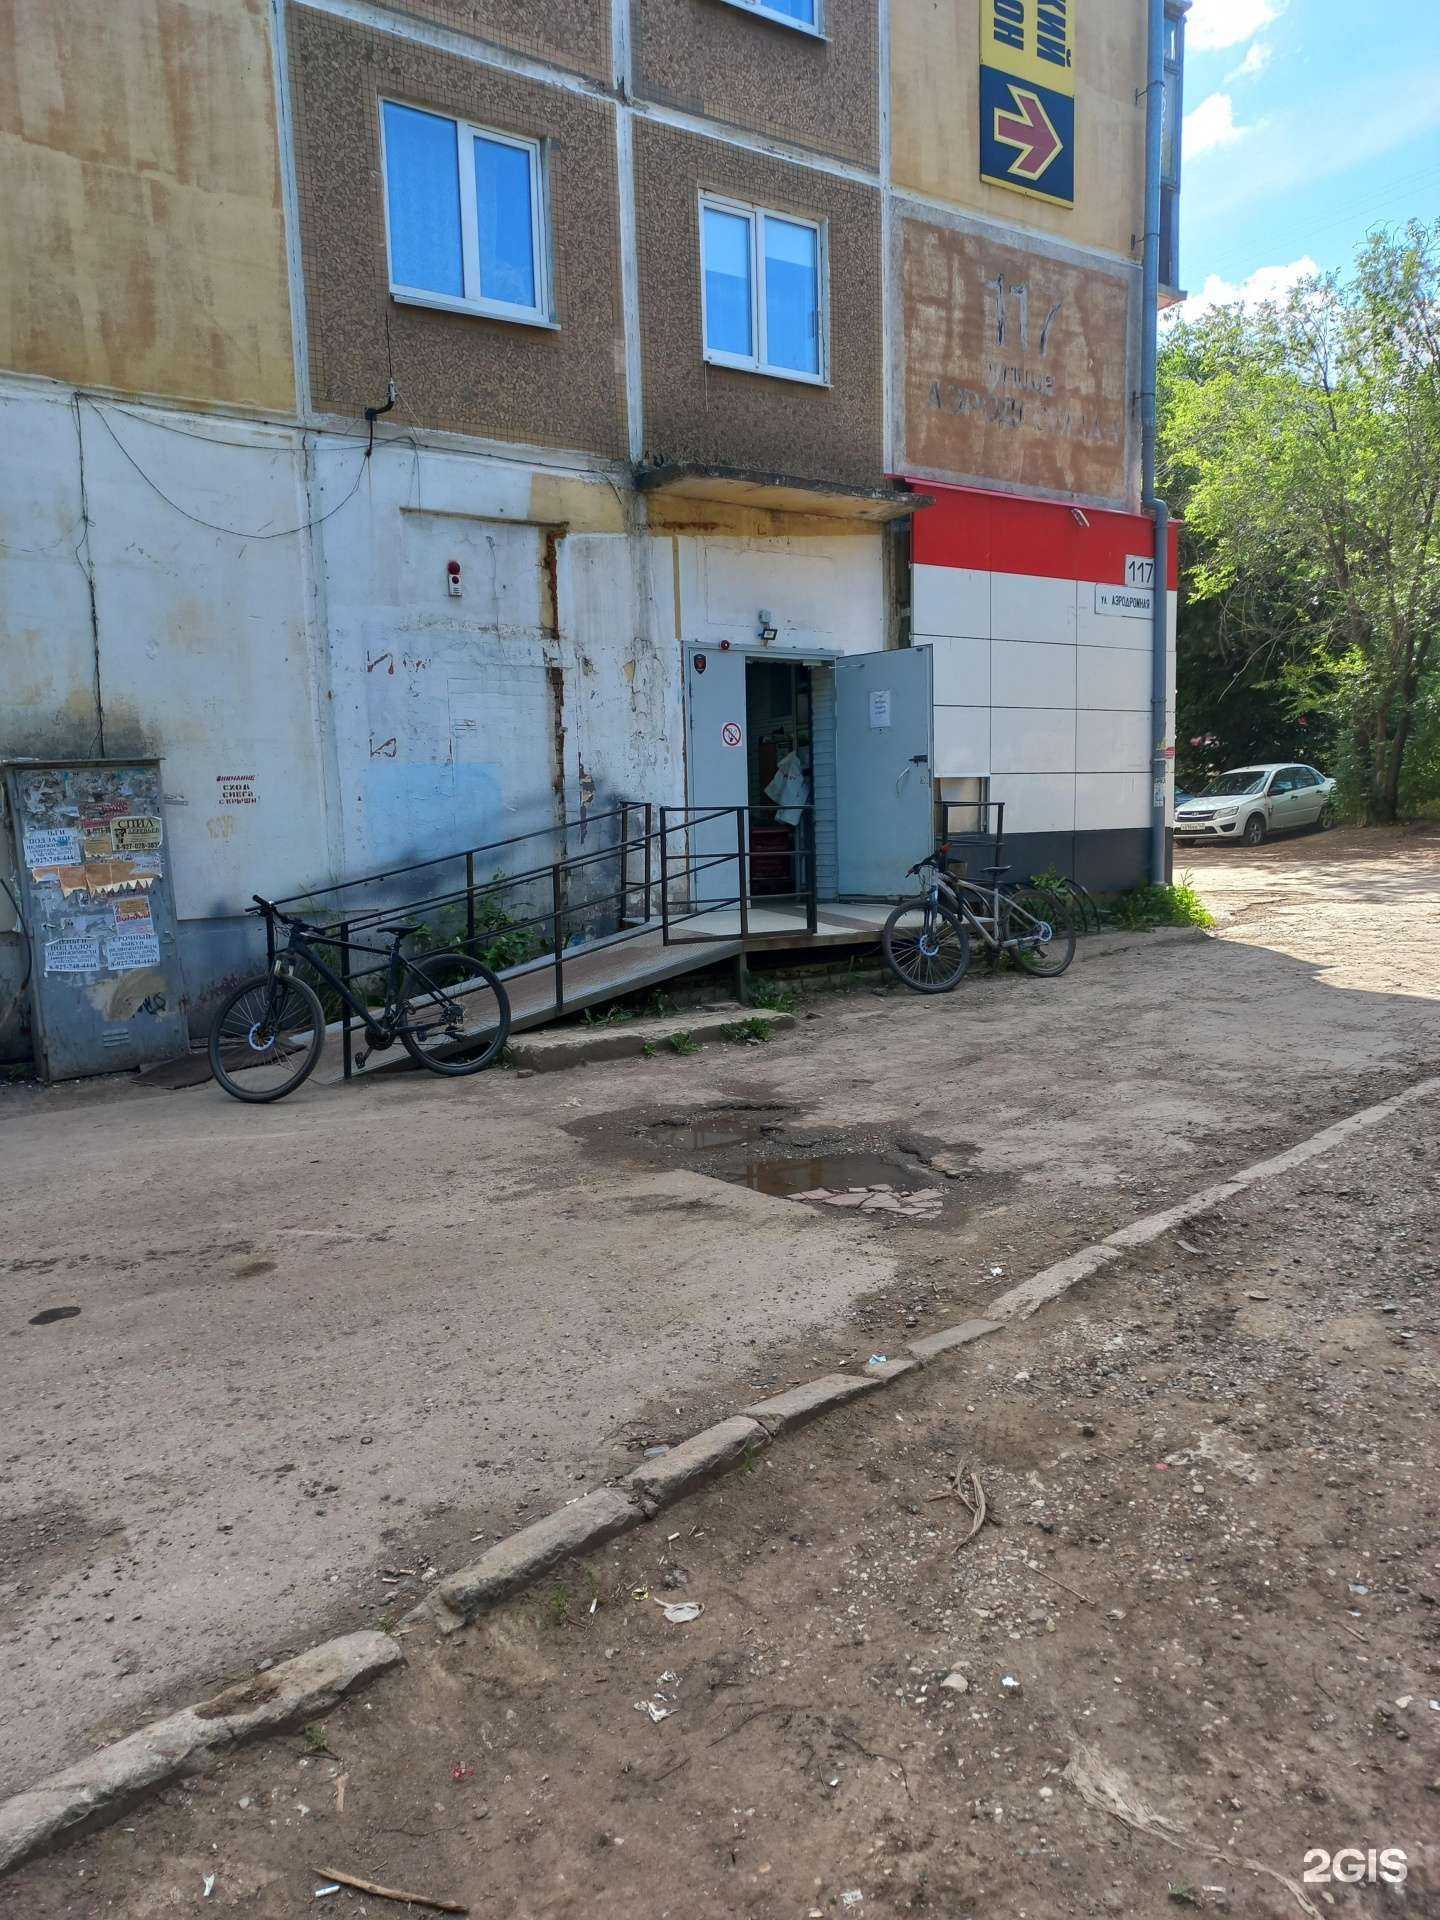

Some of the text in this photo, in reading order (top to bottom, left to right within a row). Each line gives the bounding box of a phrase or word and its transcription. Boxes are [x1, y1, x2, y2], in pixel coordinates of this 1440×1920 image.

[1128, 560, 1154, 584] 117
[1112, 595, 1150, 608] АЭРОДРОМНАЯ
[118, 819, 154, 829] СПИЛ
